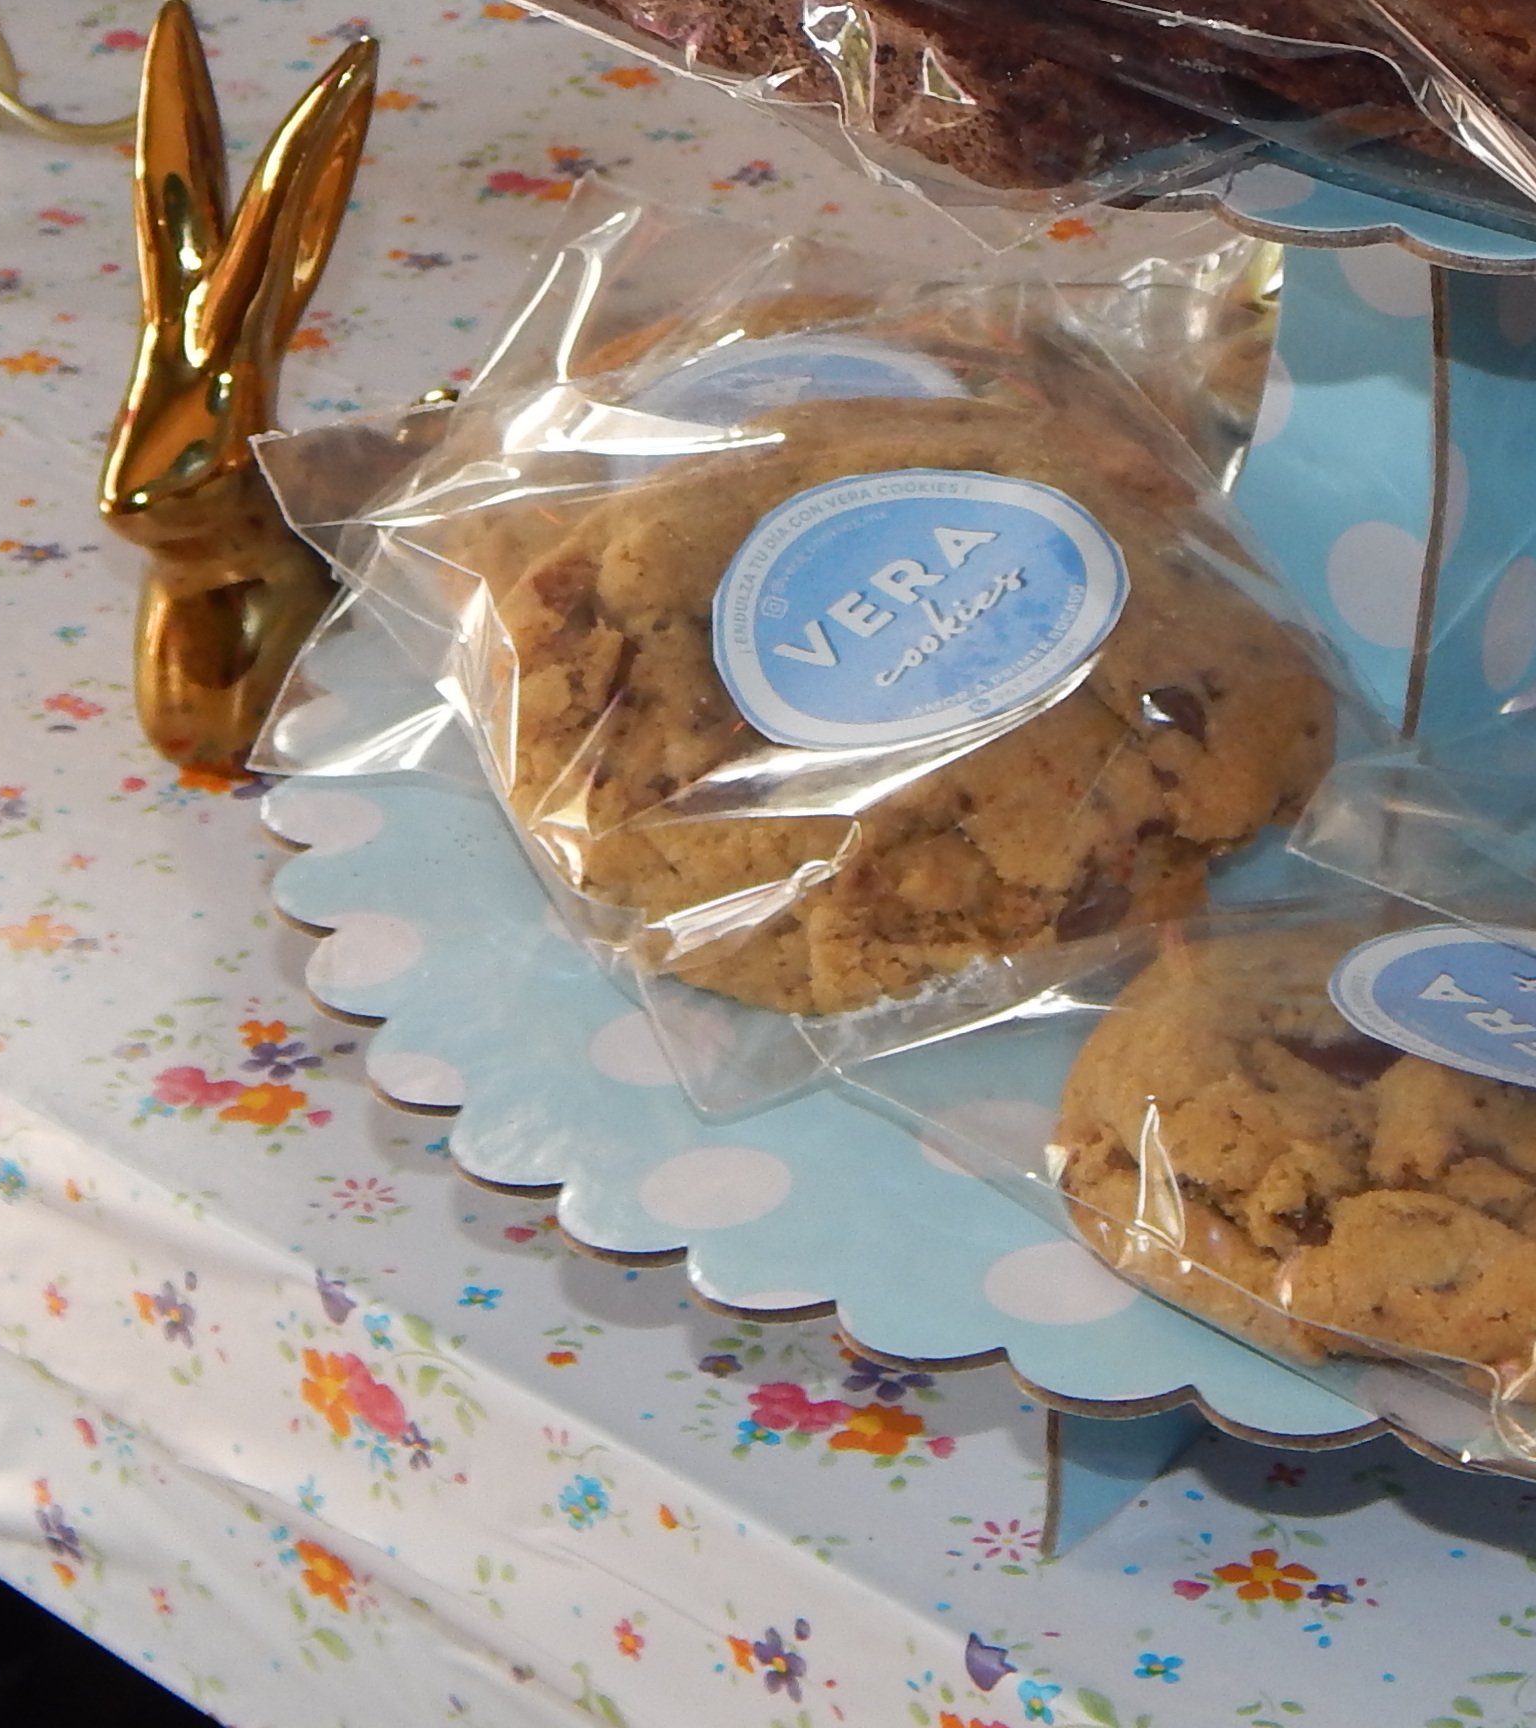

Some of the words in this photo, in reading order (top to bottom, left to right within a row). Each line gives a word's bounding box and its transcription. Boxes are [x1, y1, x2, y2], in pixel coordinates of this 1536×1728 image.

[749, 551, 770, 570] TU
[788, 503, 823, 529] CON
[826, 487, 873, 509] VERA
[773, 526, 999, 669] VERA
[875, 566, 1029, 687] cookies
